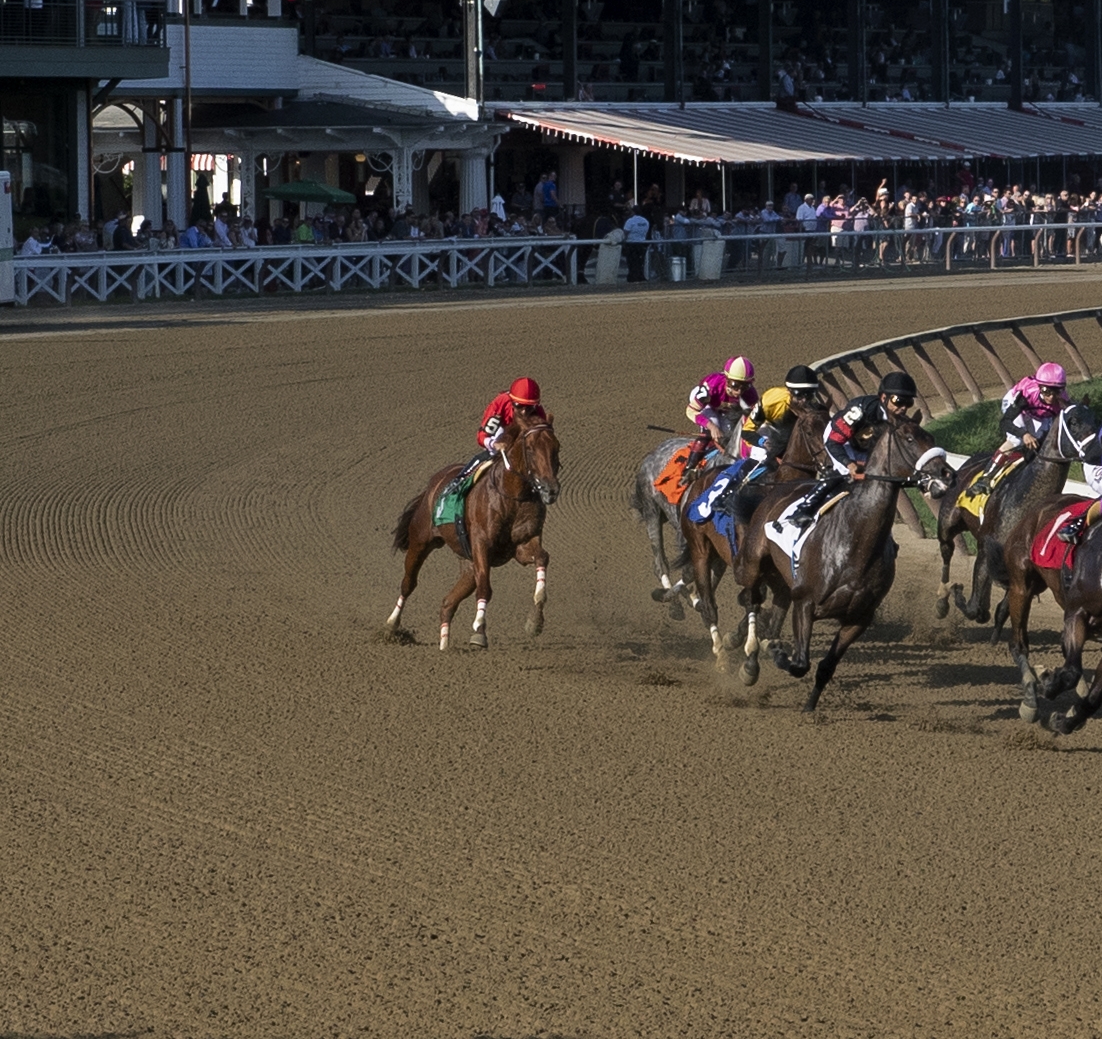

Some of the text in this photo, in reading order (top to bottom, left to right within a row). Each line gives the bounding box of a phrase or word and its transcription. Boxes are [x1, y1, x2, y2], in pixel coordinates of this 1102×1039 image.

[485, 417, 500, 435] 5
[843, 406, 863, 425] 2
[697, 478, 730, 518] 3
[1040, 511, 1072, 556] 1
